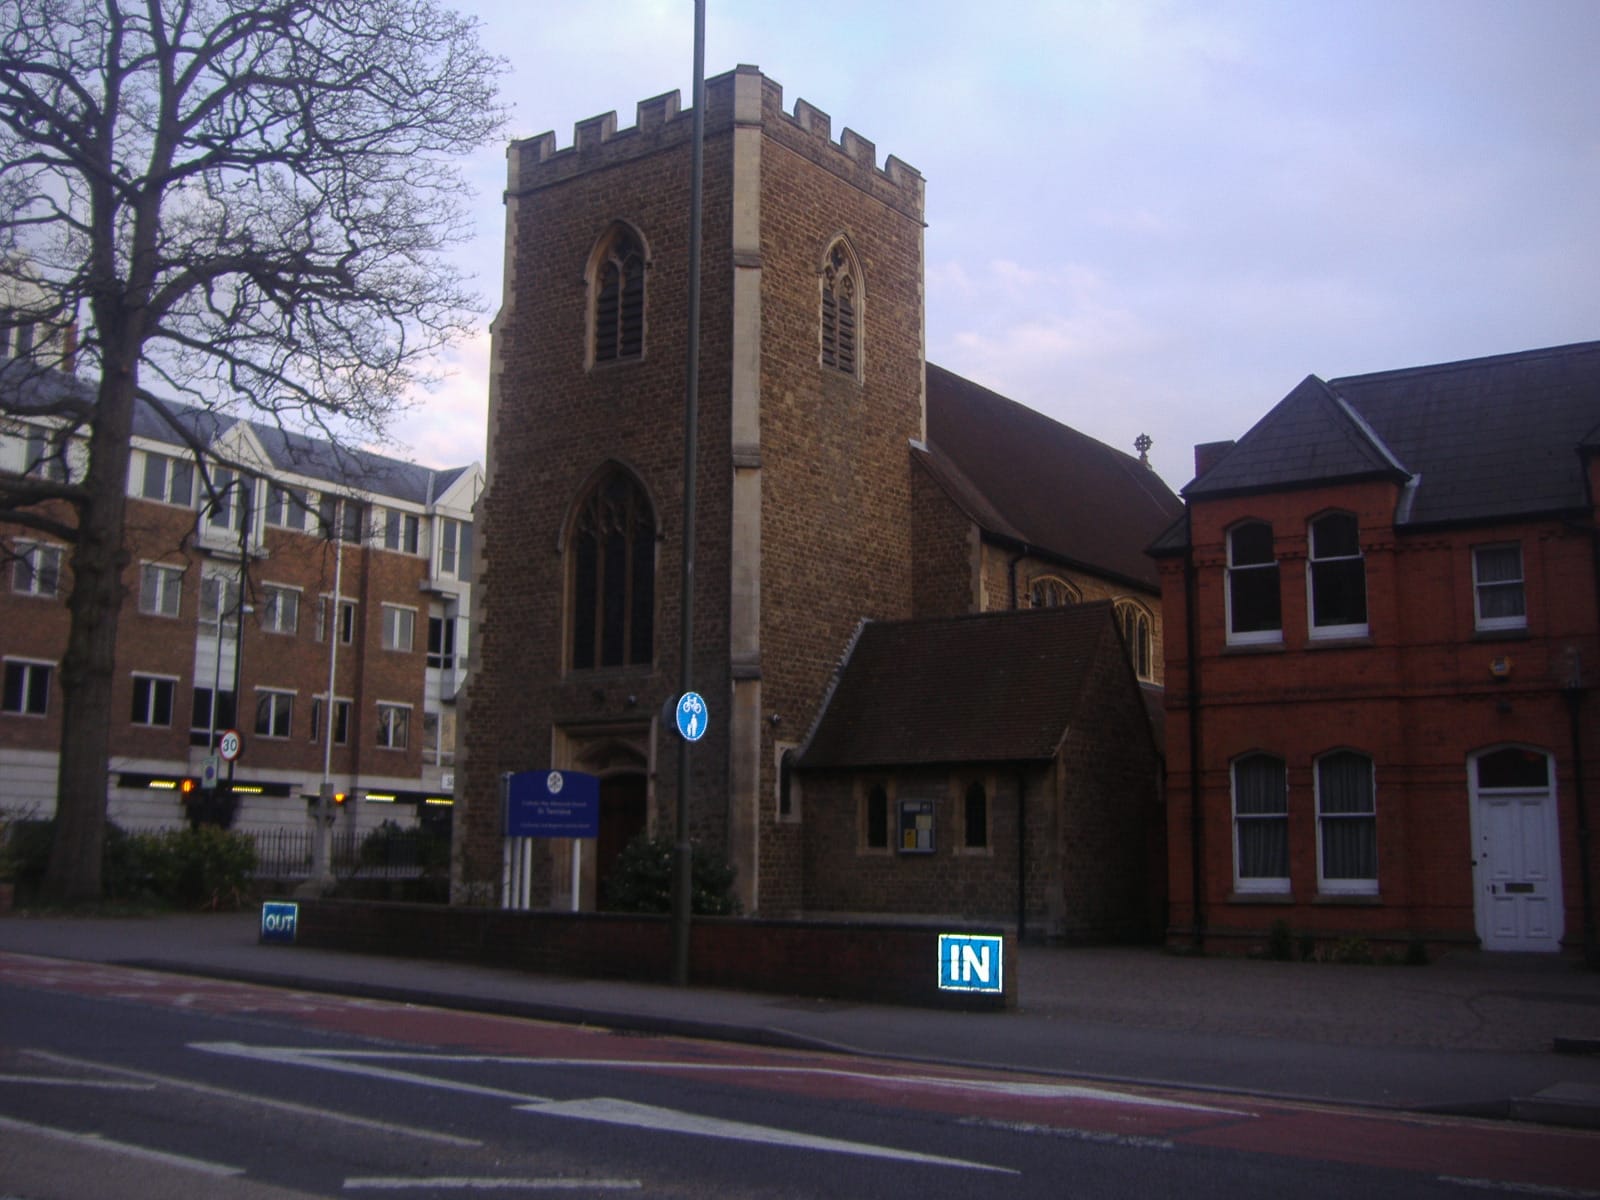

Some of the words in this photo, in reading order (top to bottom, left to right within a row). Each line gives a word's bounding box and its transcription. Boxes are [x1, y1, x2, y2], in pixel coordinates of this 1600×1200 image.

[223, 738, 238, 752] 30
[266, 914, 293, 931] OUT
[950, 944, 990, 983] IN
